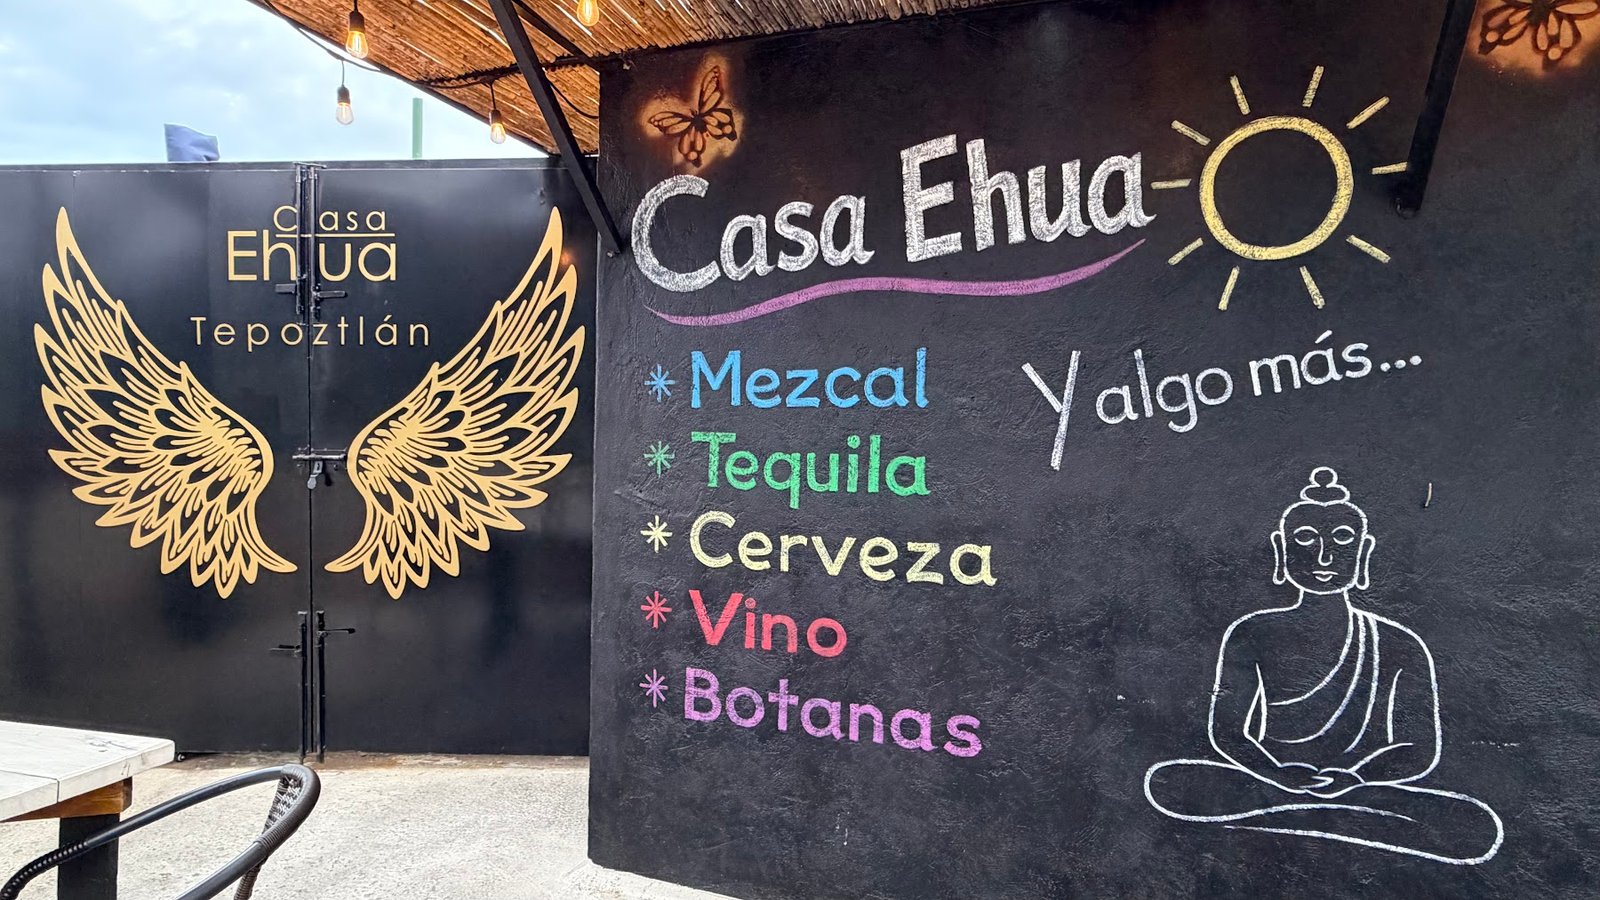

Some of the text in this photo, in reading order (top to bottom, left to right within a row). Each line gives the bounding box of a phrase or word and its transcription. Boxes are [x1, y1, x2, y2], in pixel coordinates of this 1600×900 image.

[273, 205, 386, 232] Casa
[631, 134, 1157, 292] Casa Ehua
[227, 229, 396, 282] Ehua
[190, 315, 430, 353] Tepoztlán
[690, 347, 929, 409] Mezcal
[1095, 348, 1234, 433] algo
[1248, 329, 1422, 396] más...
[690, 431, 932, 509] Tequila
[689, 511, 998, 587] Cerveza
[688, 589, 848, 658] Vino
[683, 667, 983, 758] Botanas
